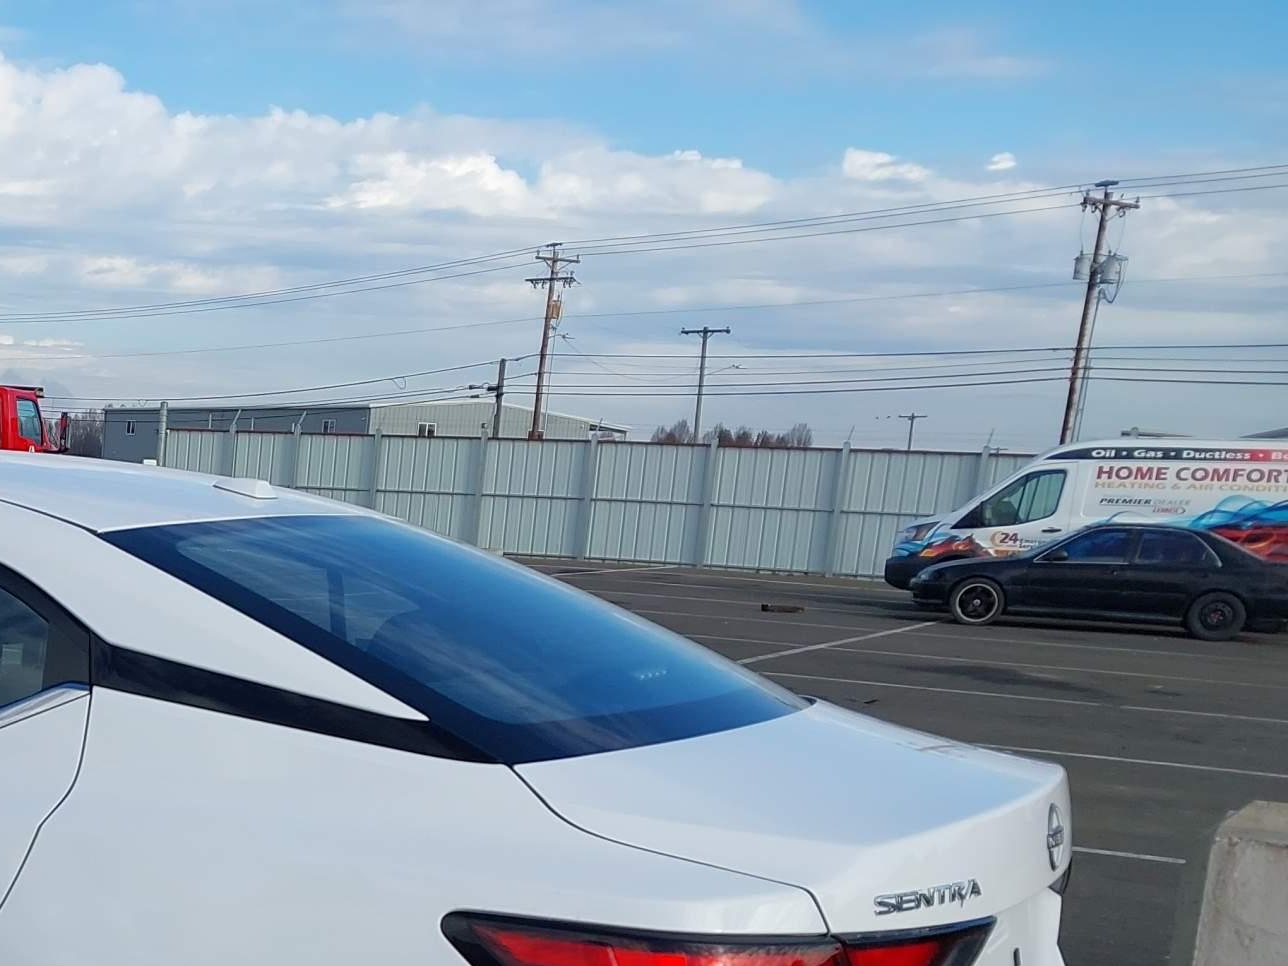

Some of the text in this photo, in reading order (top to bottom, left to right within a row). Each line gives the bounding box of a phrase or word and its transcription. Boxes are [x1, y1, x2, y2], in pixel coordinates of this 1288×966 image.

[1092, 449, 1116, 458] Oil
[1133, 449, 1164, 458] Gas
[1182, 450, 1251, 459] Ductless
[1097, 465, 1170, 481] HOME
[1095, 481, 1166, 490] HEATING
[999, 532, 1018, 544] 24
[873, 879, 982, 915] SENTRA
